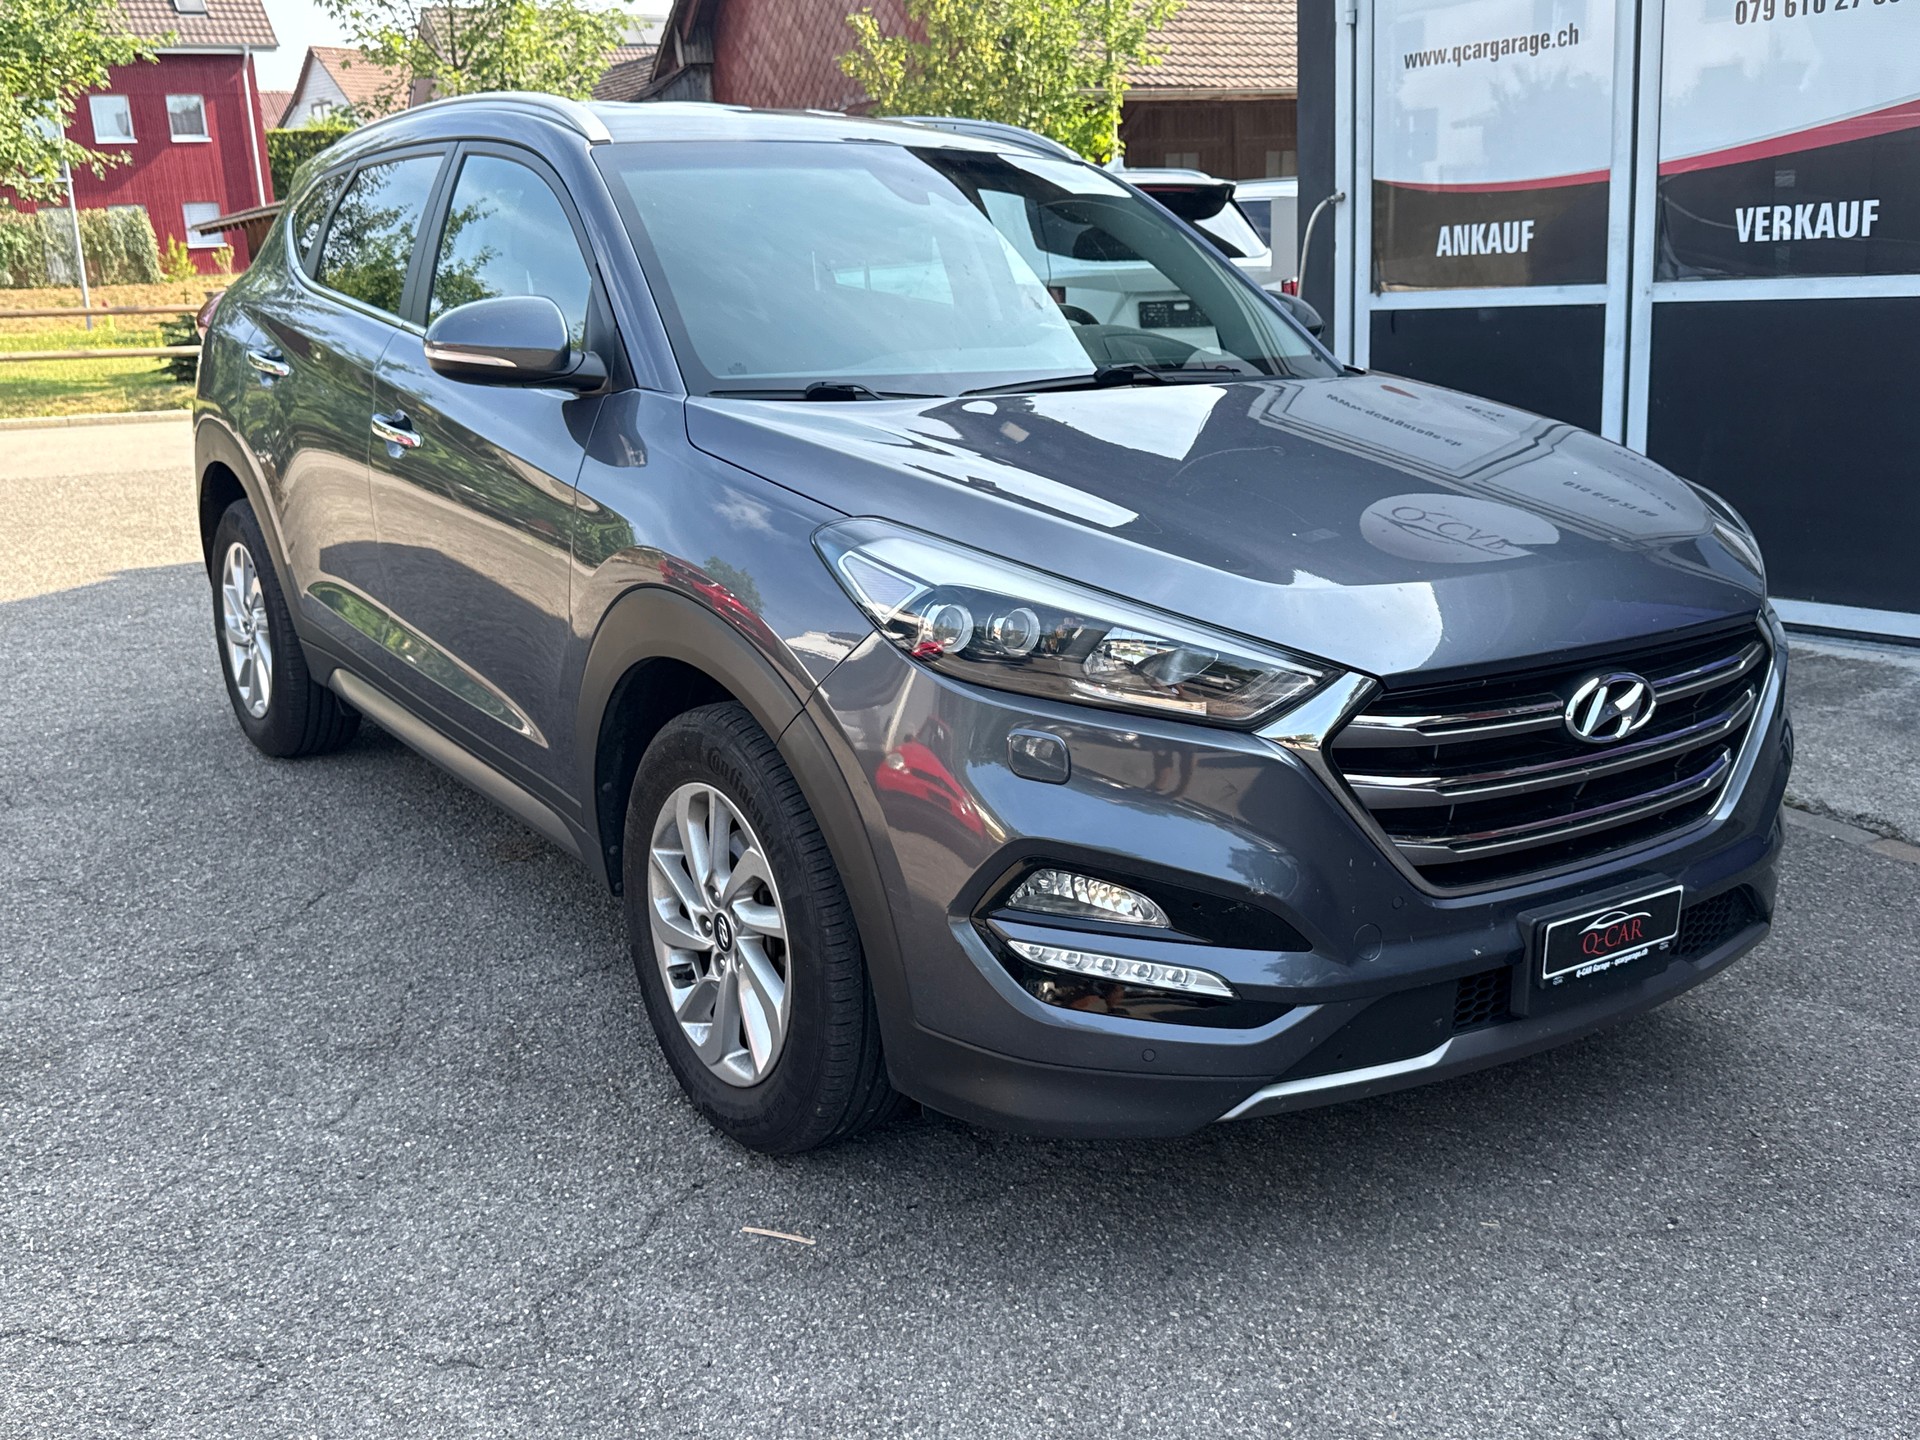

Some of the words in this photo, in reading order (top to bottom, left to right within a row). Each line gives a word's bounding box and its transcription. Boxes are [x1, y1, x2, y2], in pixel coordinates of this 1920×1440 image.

[1735, 0, 1775, 25] 079
[1404, 22, 1579, 69] www.qcargarage.ch
[1436, 219, 1535, 257] ANKAUF
[1735, 199, 1880, 243] VERKAUF
[1582, 918, 1644, 955] Q-CAR
[1592, 961, 1611, 973] Garage
